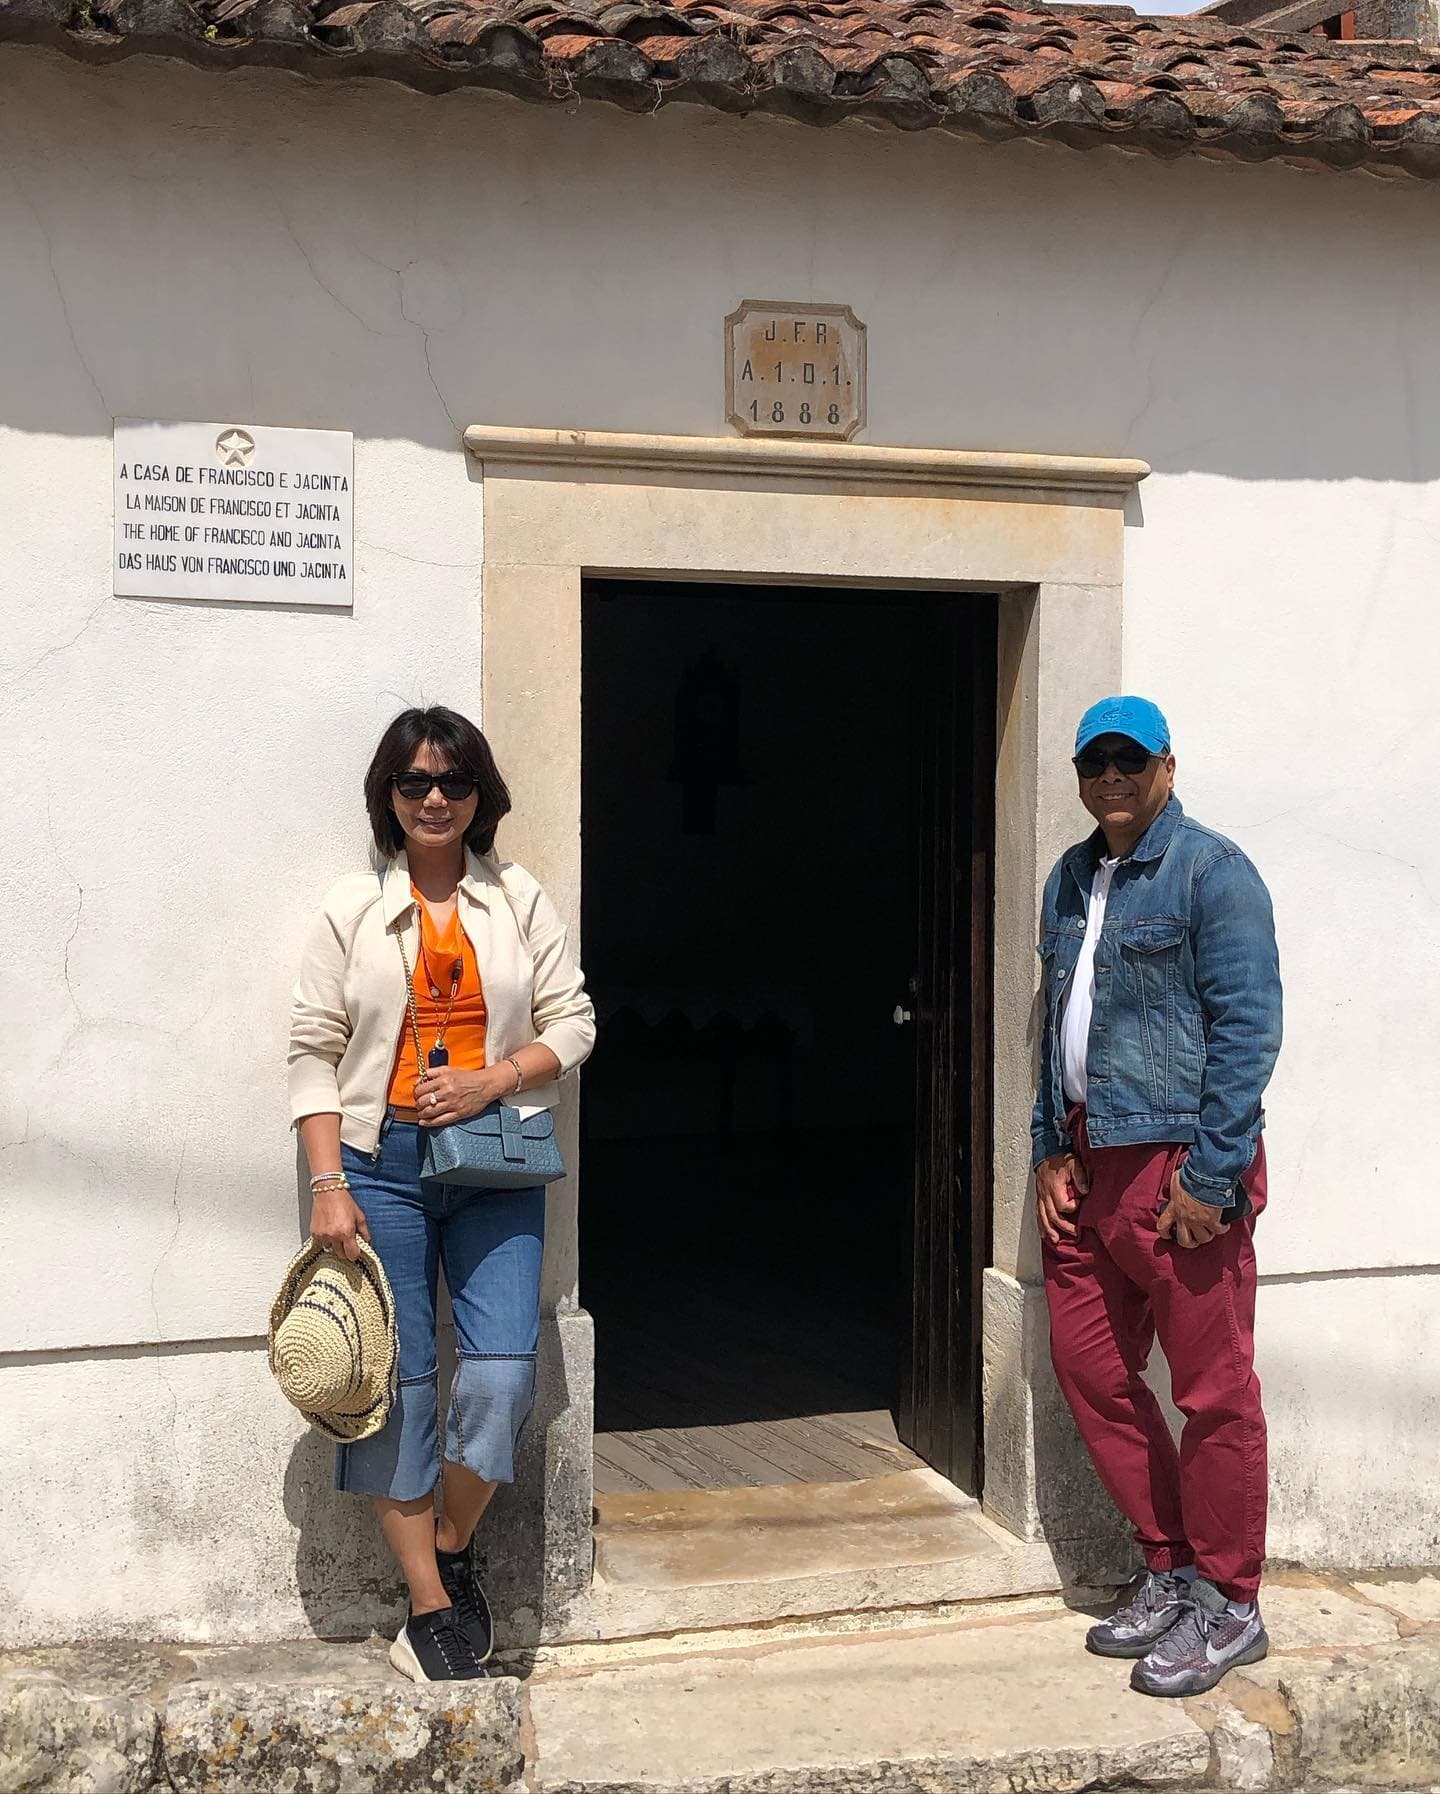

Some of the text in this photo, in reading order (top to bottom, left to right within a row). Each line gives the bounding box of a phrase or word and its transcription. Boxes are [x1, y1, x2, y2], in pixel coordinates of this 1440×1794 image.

[750, 400, 840, 424] 1888
[120, 464, 348, 492] A CASA DE FRANCISCO E JACINTA
[126, 494, 340, 521] LA MAISON DE FRANCISCO ET JACINTA
[123, 523, 341, 550] THE HOME OF FRANCISCO AND JACINTA
[119, 553, 346, 579] DAS HAUS VON FRANCISCO UND JACINTA
